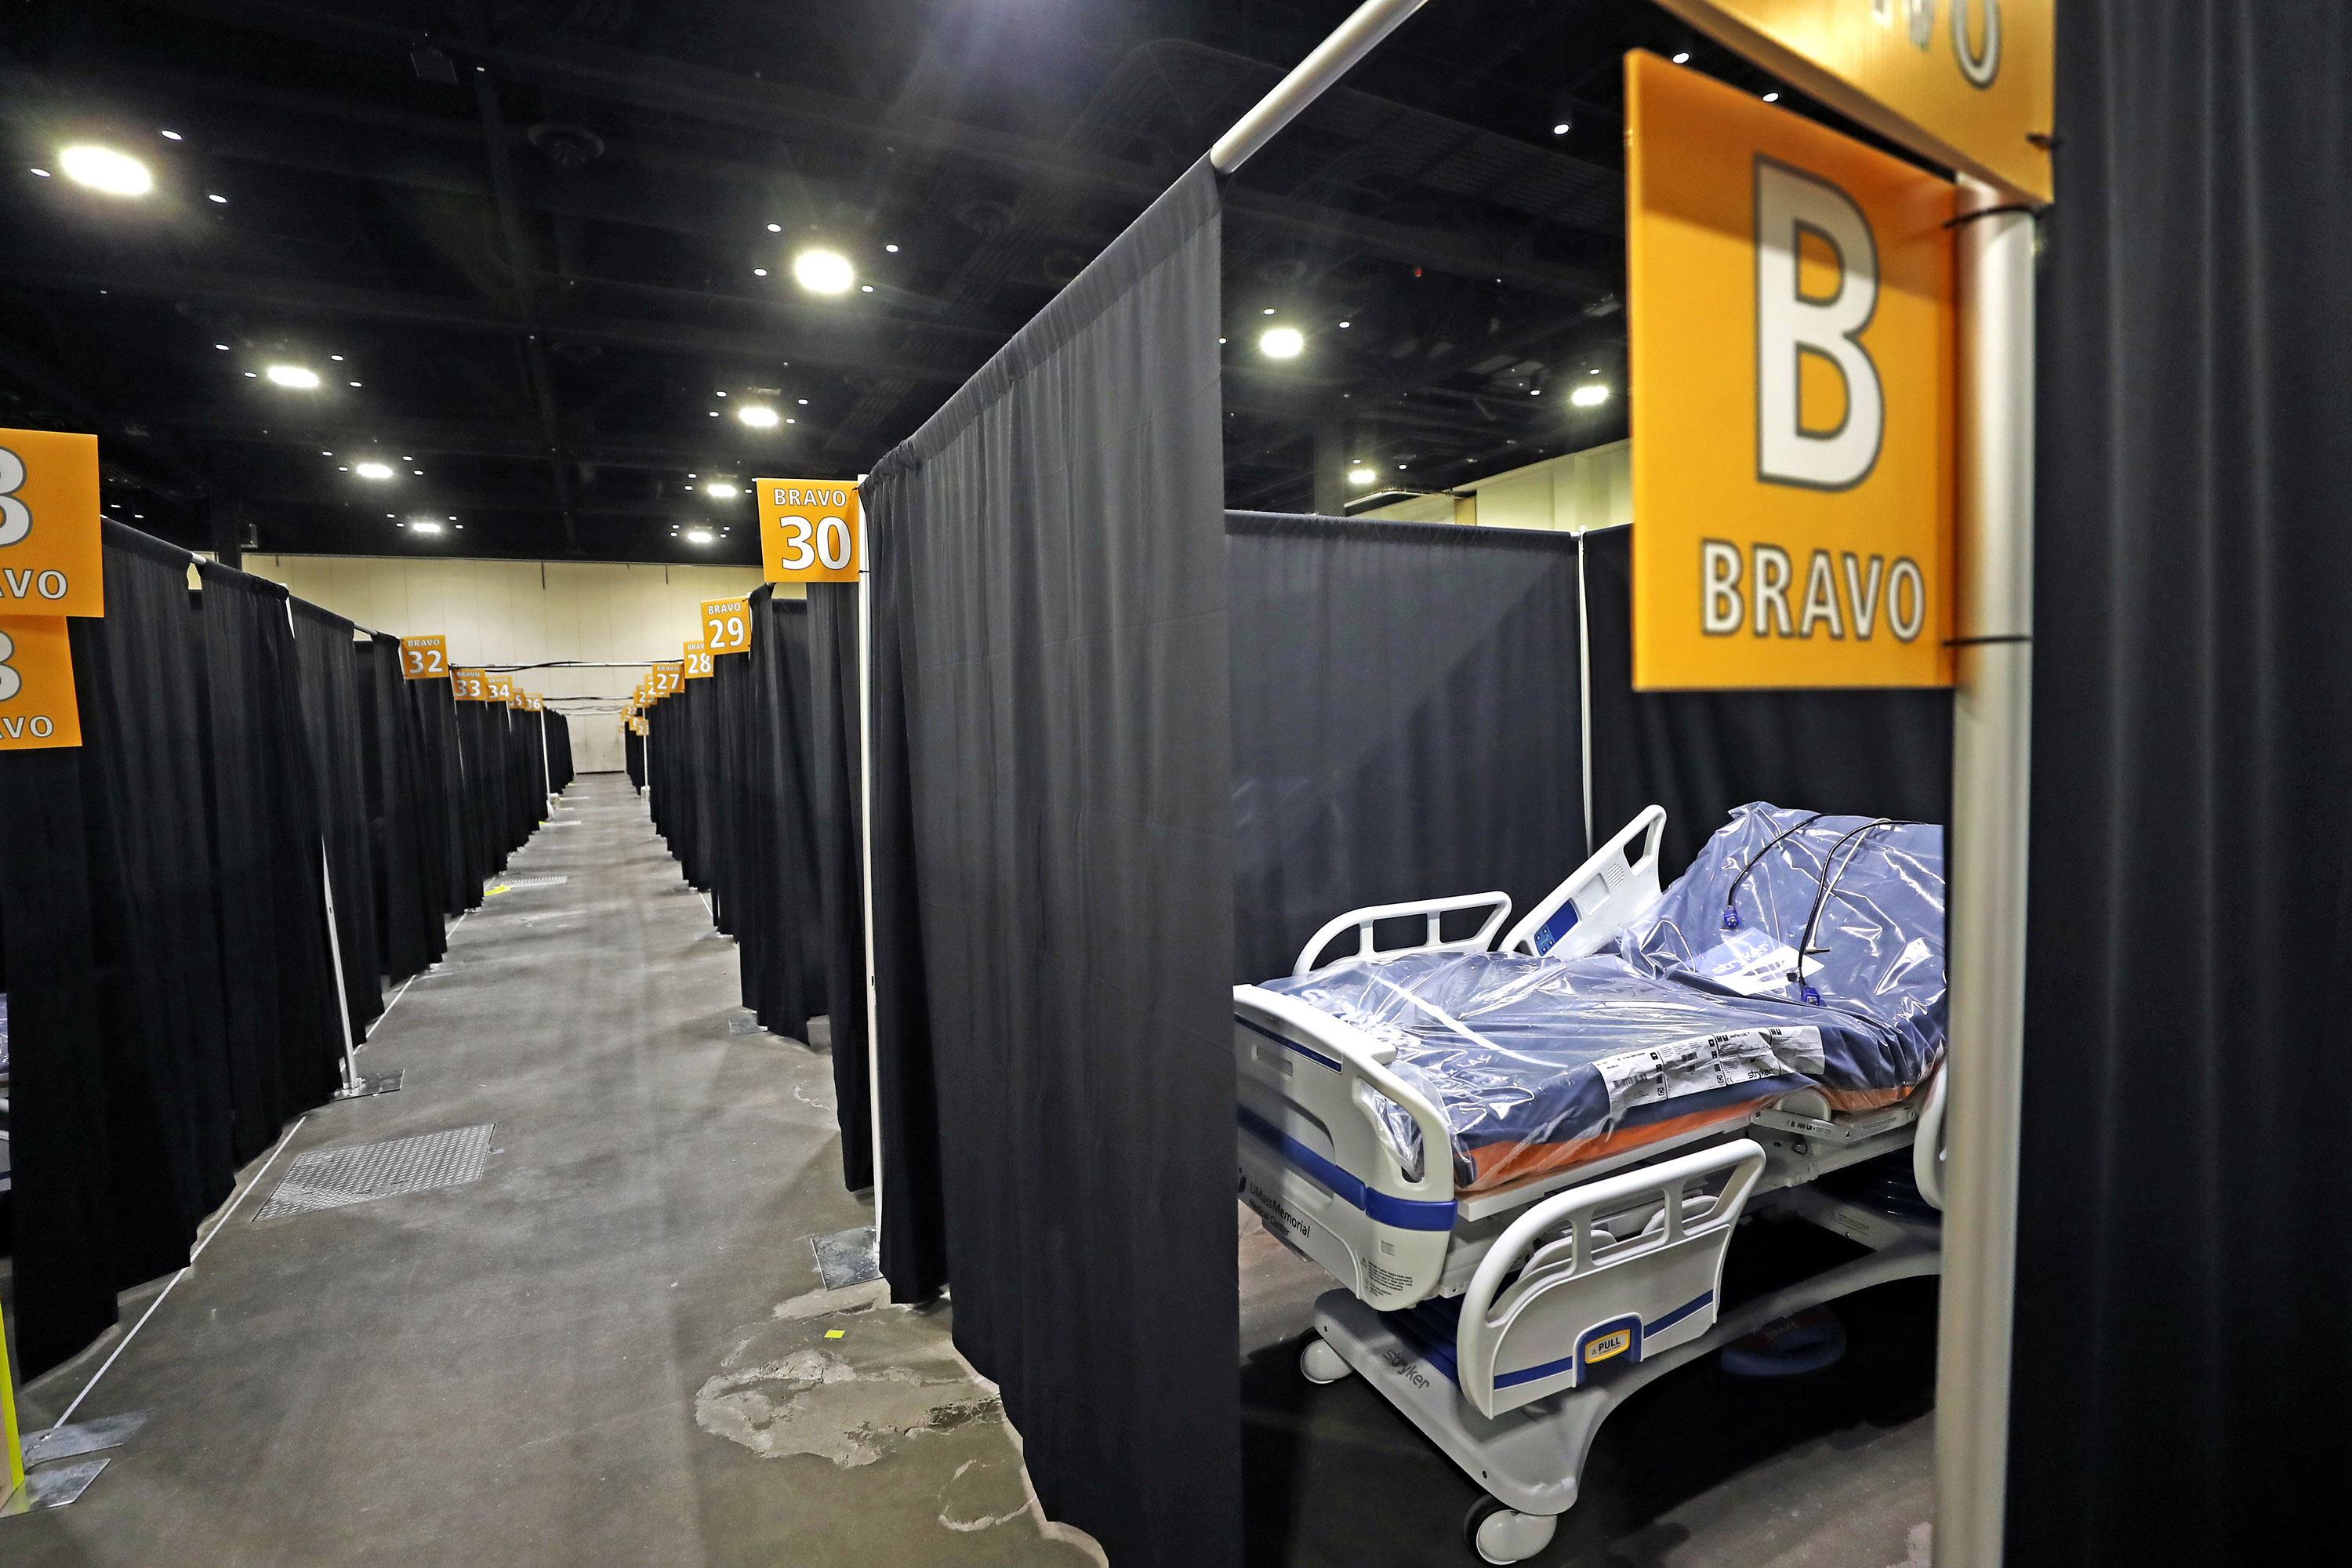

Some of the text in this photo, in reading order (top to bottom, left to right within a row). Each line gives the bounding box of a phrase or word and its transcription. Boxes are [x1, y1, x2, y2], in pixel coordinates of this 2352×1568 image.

[1752, 150, 1884, 492] B
[774, 488, 846, 506] BRAVO
[779, 514, 852, 571] 30
[1700, 537, 1926, 644] BRAVO
[708, 602, 741, 615] BRAVO
[708, 616, 745, 649] 29
[408, 650, 444, 673] 32
[688, 652, 711, 674] 28
[456, 679, 481, 697] 33
[656, 673, 680, 690] 27
[488, 684, 510, 699] 34
[525, 699, 541, 710] 36
[1748, 1068, 1774, 1080] stryker
[1599, 1337, 1621, 1352] PULL
[1382, 1348, 1430, 1389] stryker
